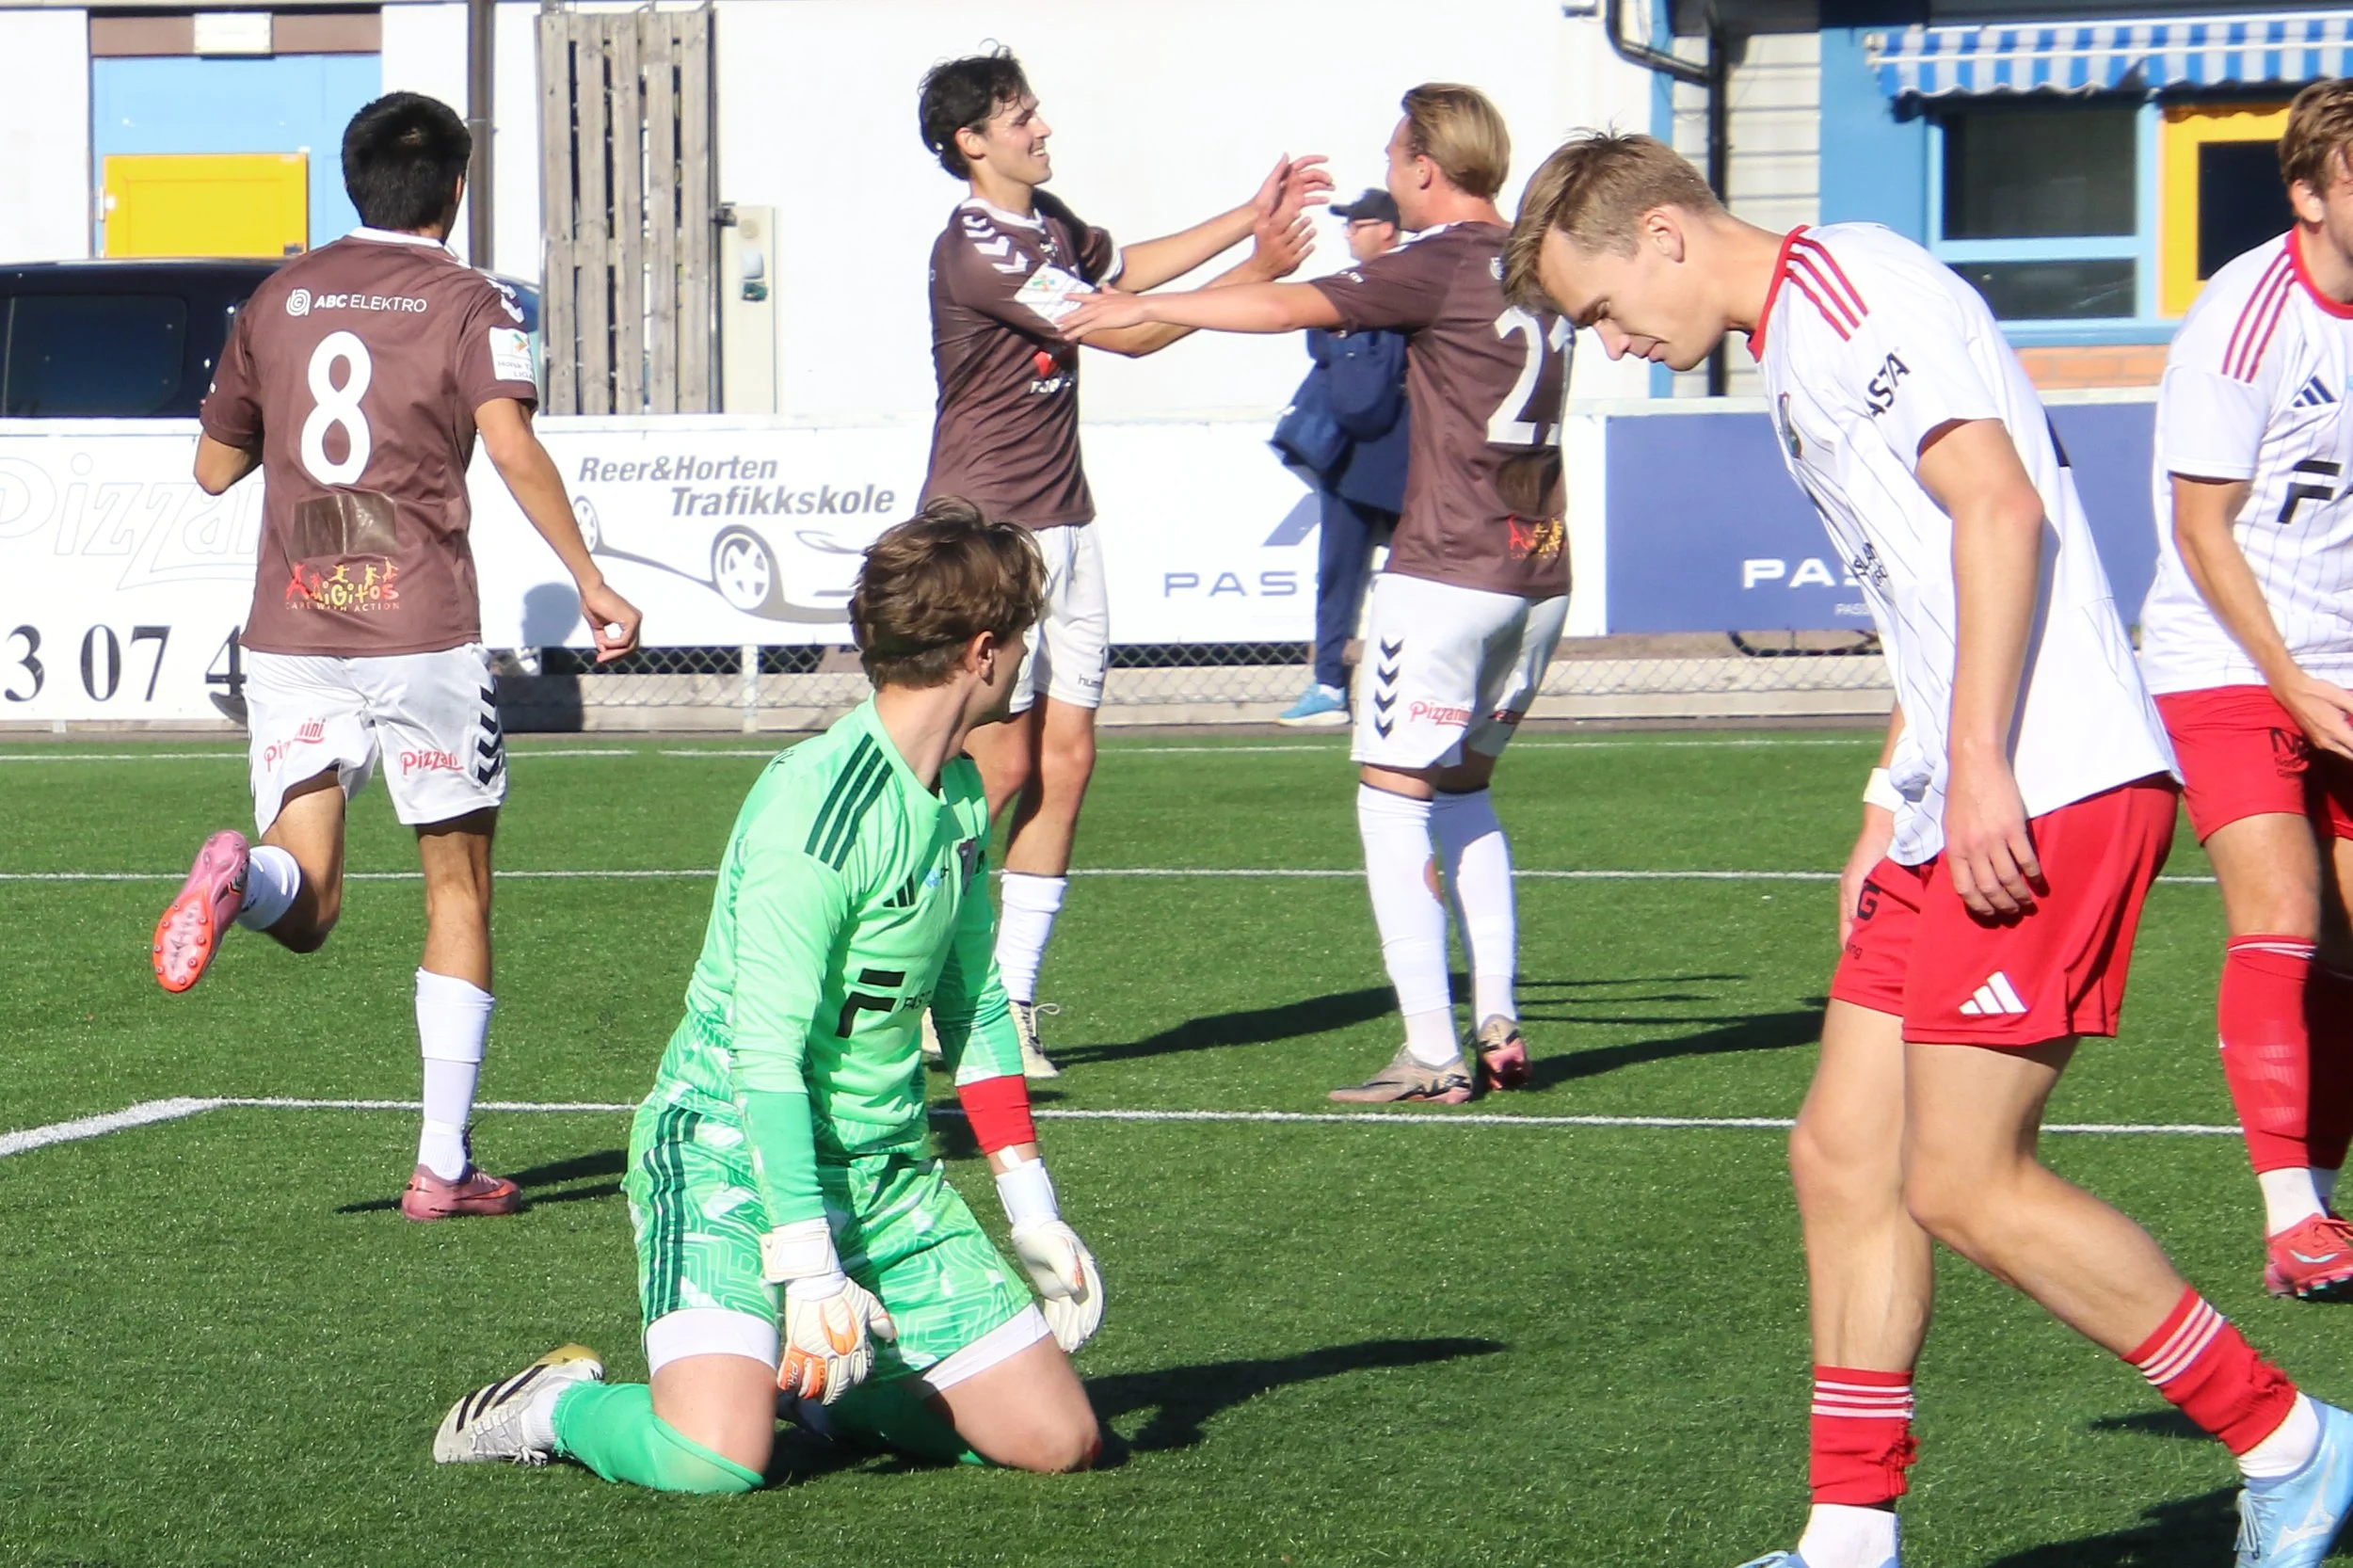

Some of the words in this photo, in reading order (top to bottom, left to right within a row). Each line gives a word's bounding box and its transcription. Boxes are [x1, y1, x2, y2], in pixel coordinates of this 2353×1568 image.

[314, 294, 348, 309] ABC
[349, 294, 427, 313] ELEKTRO
[300, 330, 372, 486] 8
[578, 455, 778, 482] Reer&Horten
[670, 484, 896, 517] Trafikkskole
[353, 602, 400, 613] ACTION
[80, 624, 171, 702] 07
